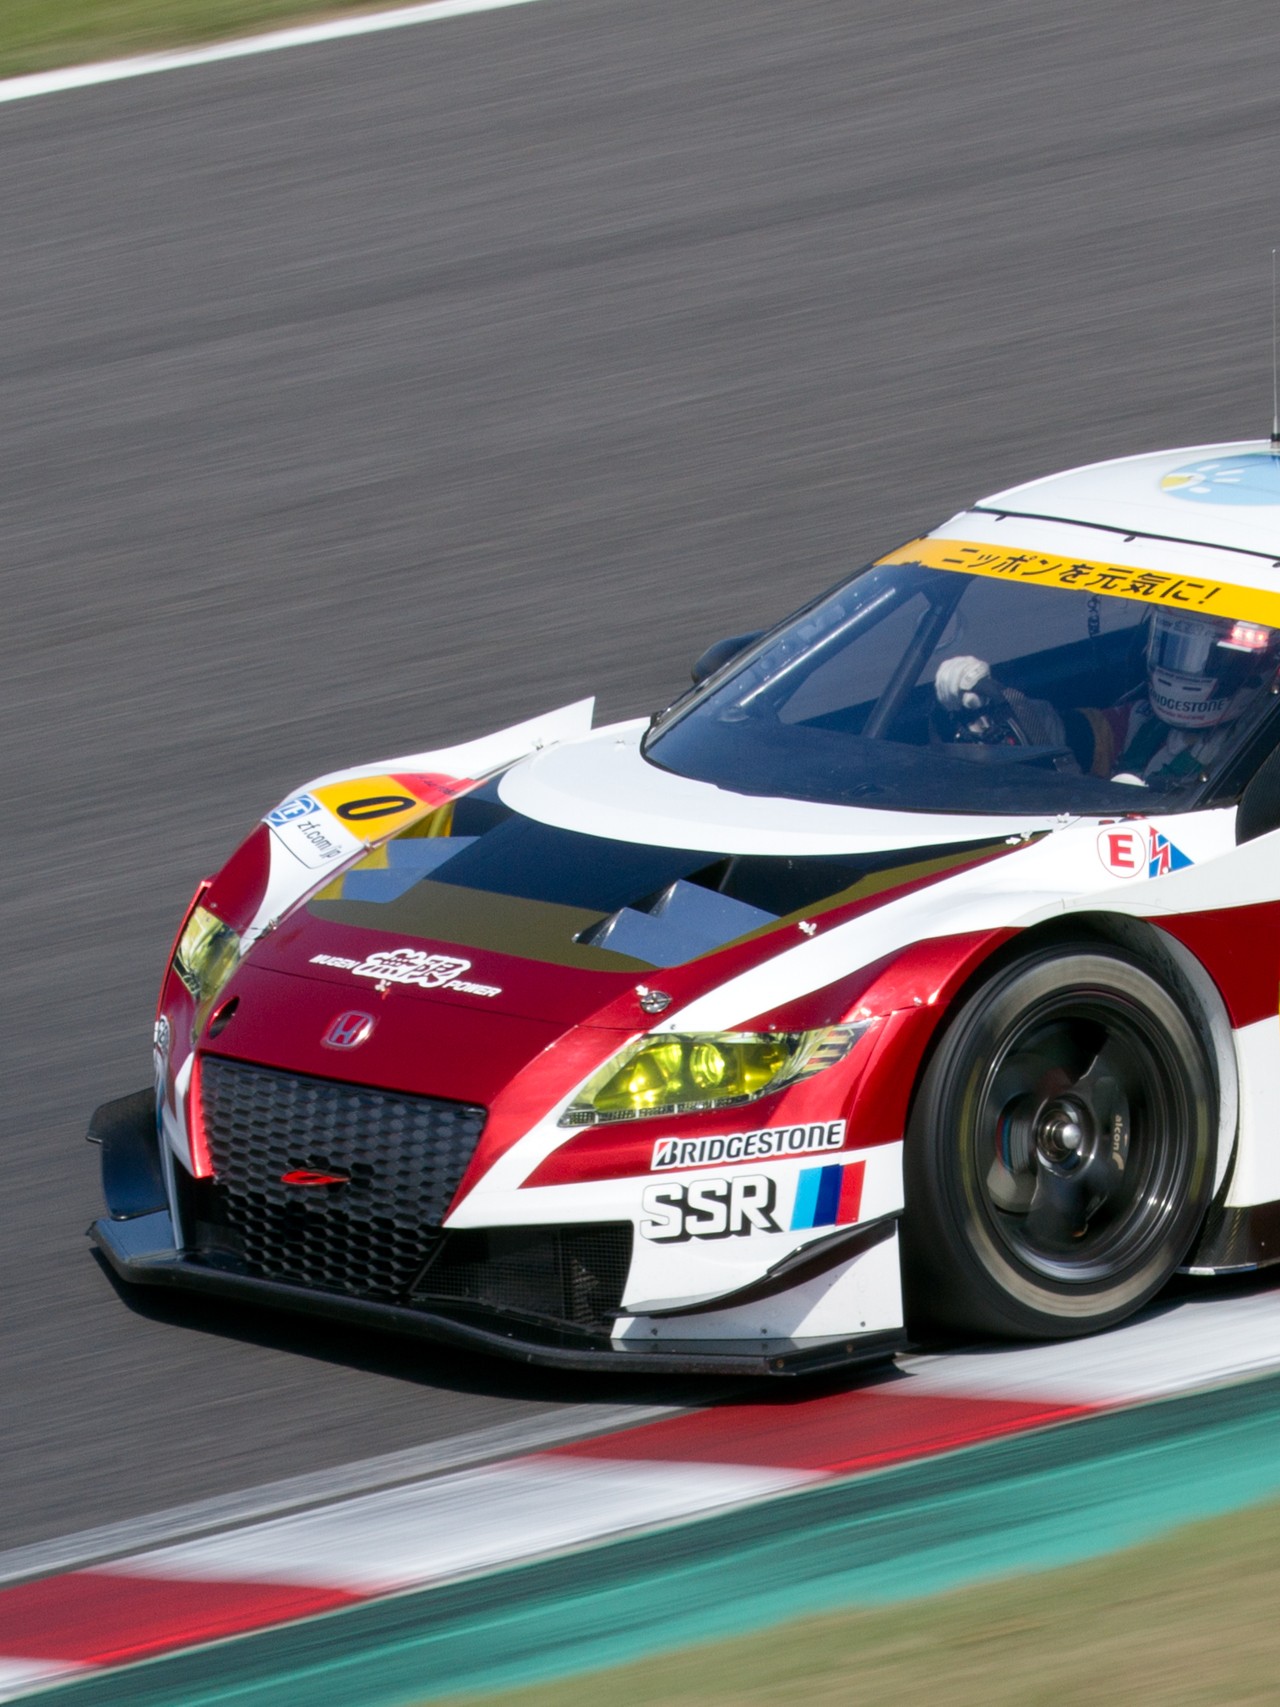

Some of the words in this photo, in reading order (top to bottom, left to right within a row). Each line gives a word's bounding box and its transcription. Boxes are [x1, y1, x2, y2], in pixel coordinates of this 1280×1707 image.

[942, 547, 1222, 605] ニッポンを元気に!
[336, 795, 417, 821] 0
[1107, 834, 1135, 869] E
[308, 954, 361, 970] MUGEN
[442, 980, 503, 997] POWER
[654, 1121, 843, 1167] BRIDGESTONE
[1113, 1114, 1123, 1151] alcon
[640, 1174, 785, 1244] SSR
